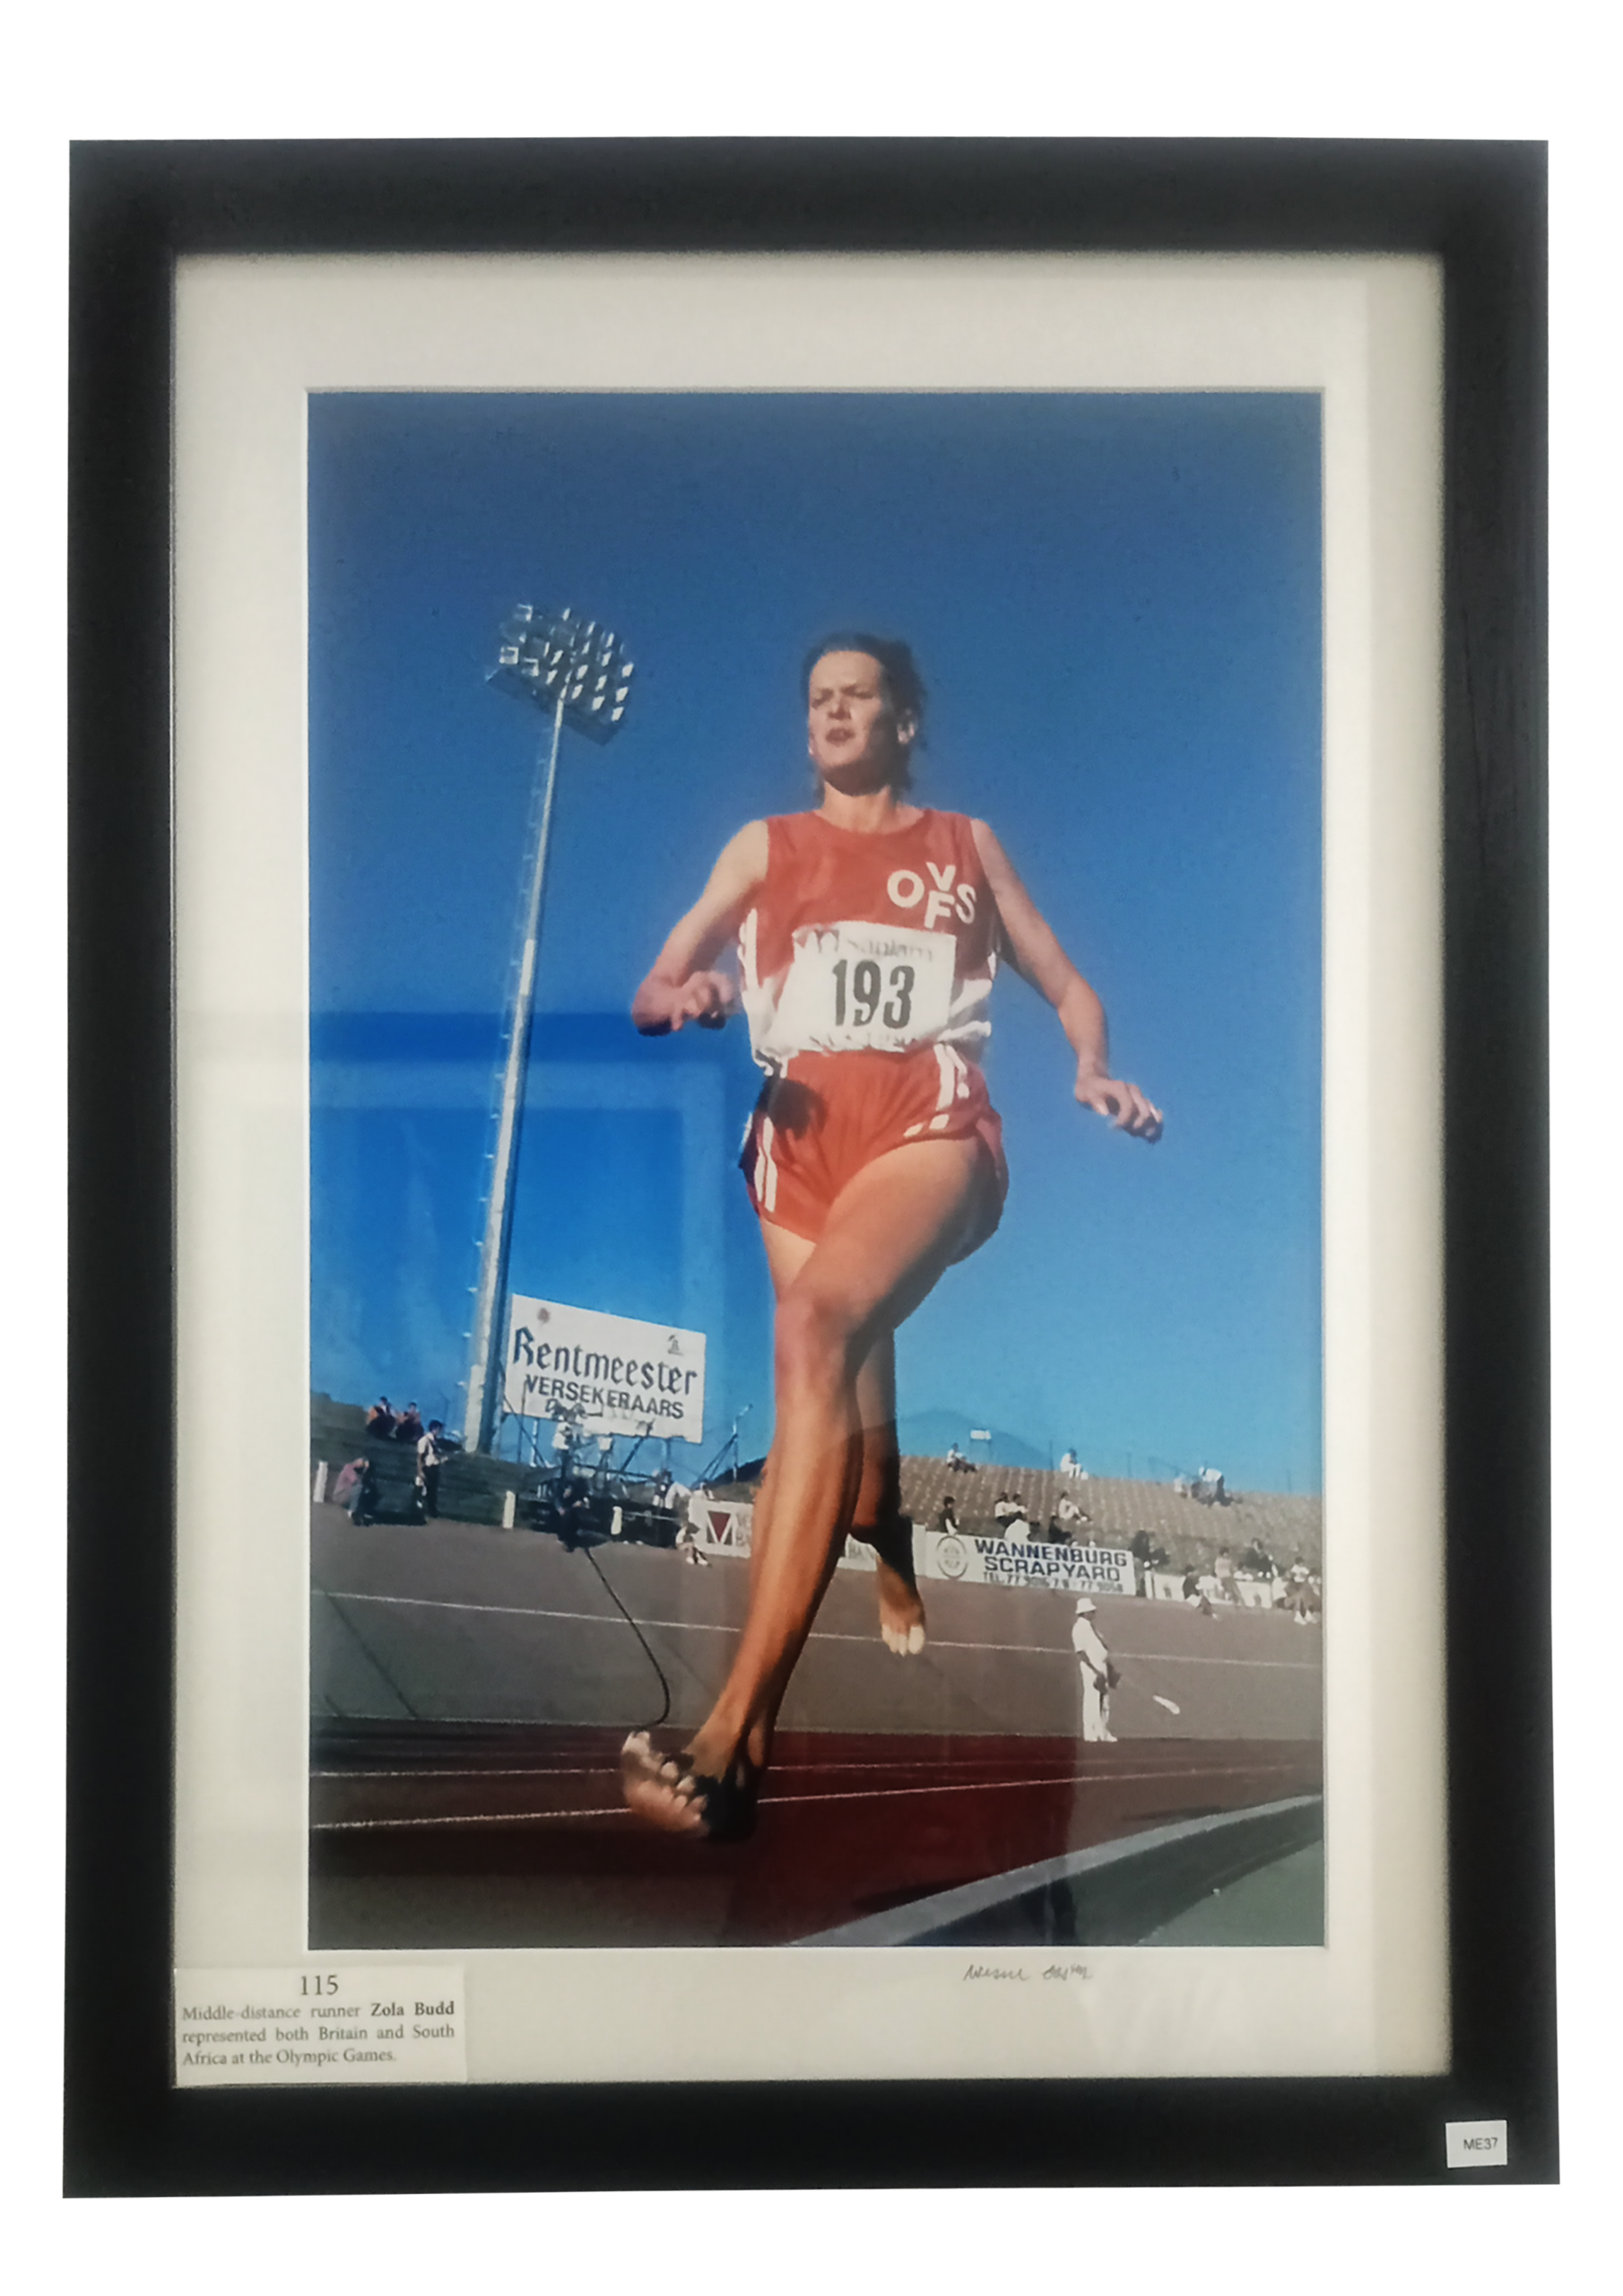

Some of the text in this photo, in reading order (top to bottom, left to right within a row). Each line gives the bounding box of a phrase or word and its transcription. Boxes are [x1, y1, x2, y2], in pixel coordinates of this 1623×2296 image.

[832, 959, 916, 1030] 193
[513, 1326, 698, 1396] Rentmeester
[525, 1374, 684, 1420] VERSEKERAARS
[975, 1538, 1128, 1568] WANNENBURG
[984, 1555, 1121, 1582] SCRAPYARD
[300, 1974, 339, 1996] 115
[182, 2001, 455, 2021] Middle-distance runner Zola Budd
[182, 2023, 455, 2047] represented both Britain and South
[183, 2048, 397, 2067] Africa at the Olympic Games.
[1463, 2137, 1498, 2151] ME37
